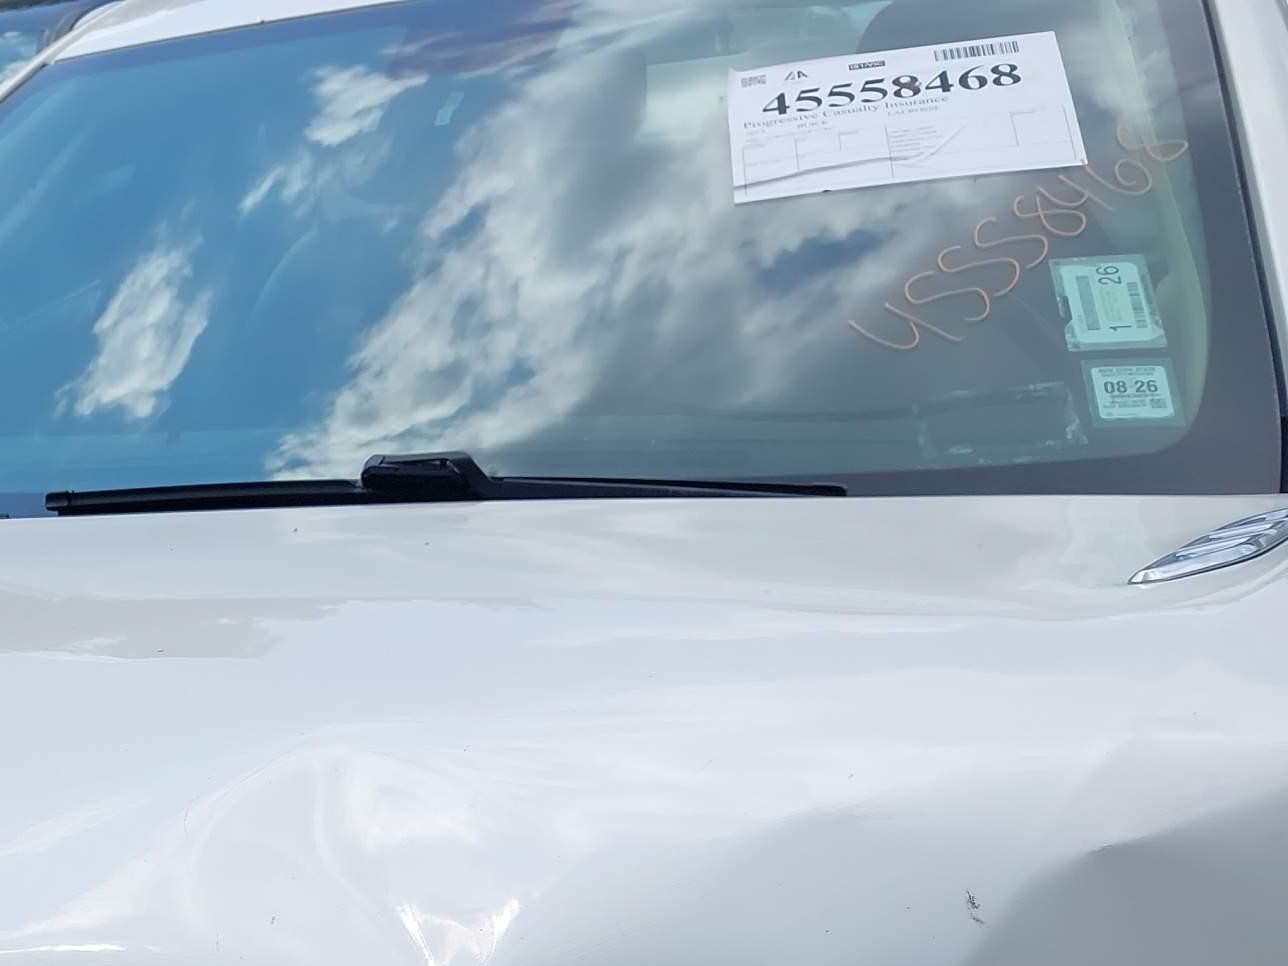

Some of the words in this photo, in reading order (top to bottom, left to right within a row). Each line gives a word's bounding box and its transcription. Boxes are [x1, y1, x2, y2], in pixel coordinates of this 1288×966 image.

[762, 63, 1022, 116] 45558468
[743, 113, 819, 130] Progressive
[822, 104, 880, 119] Casualty
[883, 96, 949, 110] Insurance
[847, 110, 1189, 350] 45558468
[1095, 265, 1122, 286] 26
[1103, 380, 1128, 394] 08
[1134, 379, 1159, 393] 26
